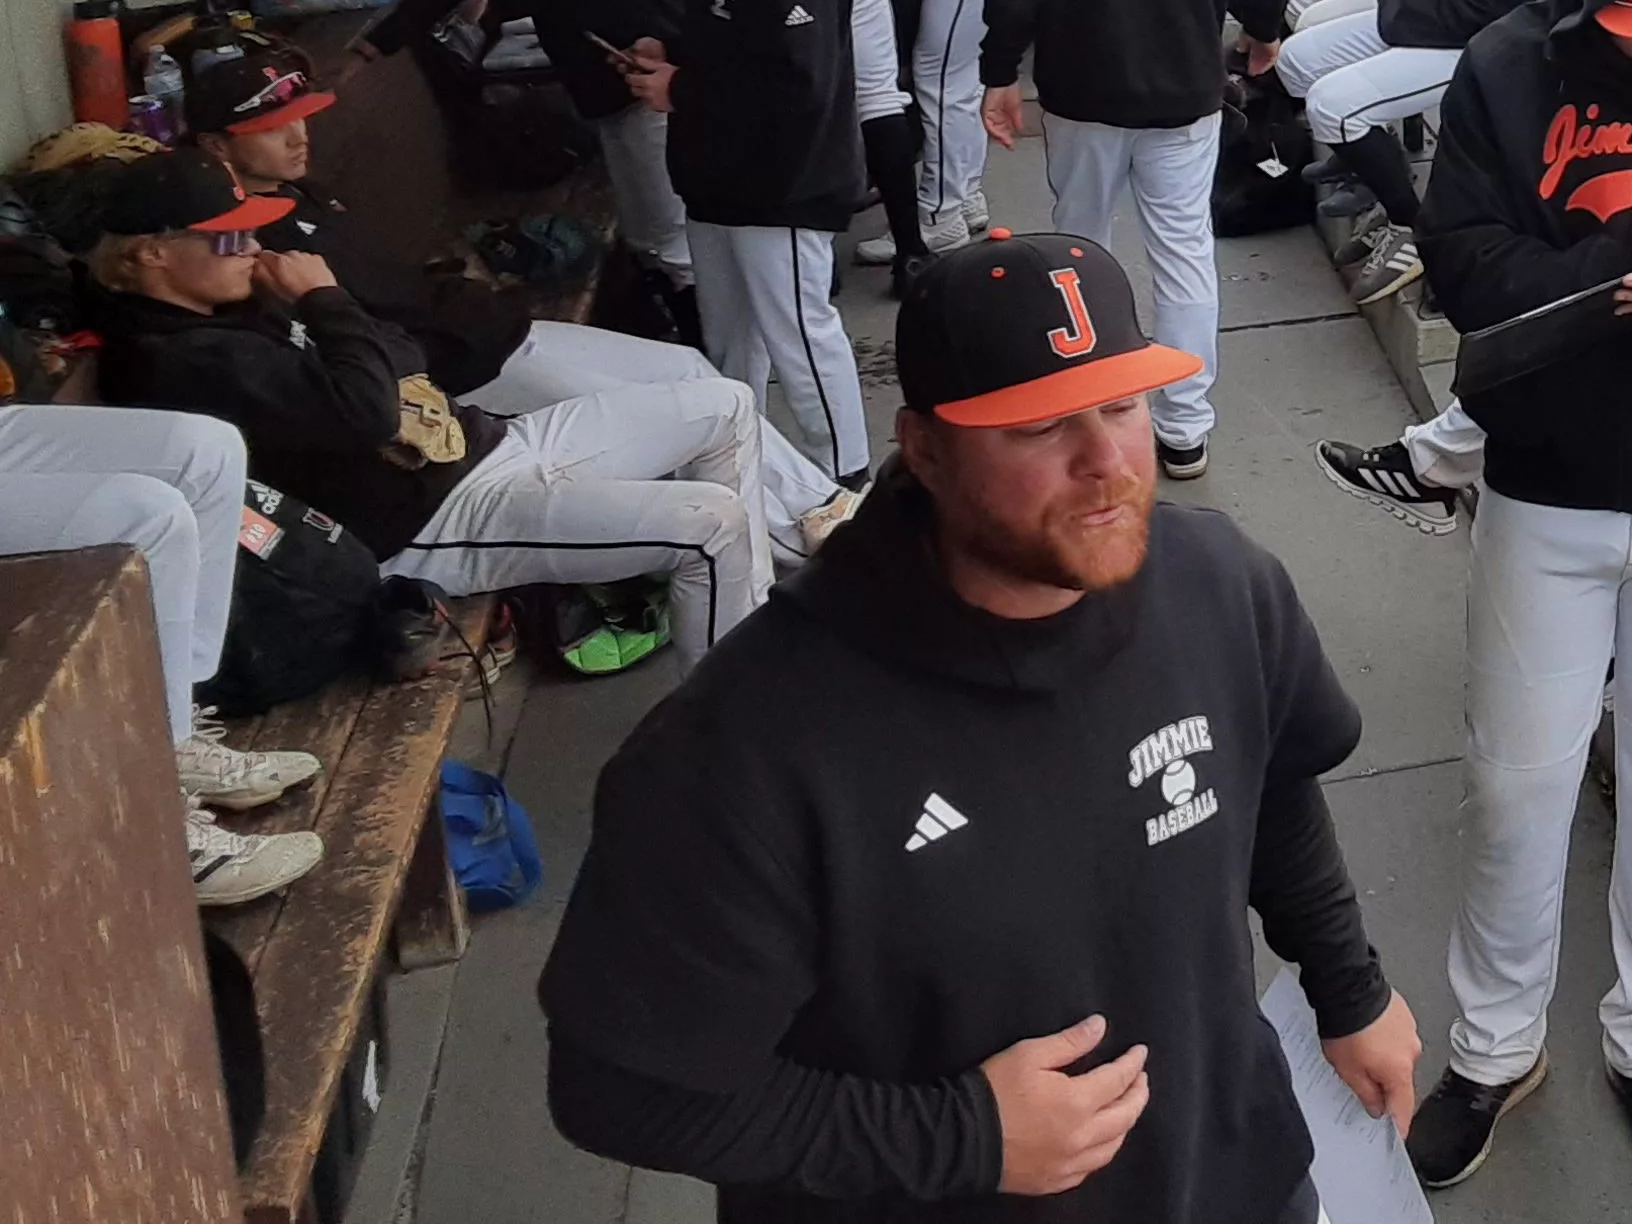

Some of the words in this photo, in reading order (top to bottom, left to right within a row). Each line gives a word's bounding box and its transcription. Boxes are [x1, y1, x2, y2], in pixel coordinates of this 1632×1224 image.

[1047, 267, 1097, 359] J
[1128, 715, 1213, 788] JIMMIE
[1146, 787, 1218, 846] BASEBALL
